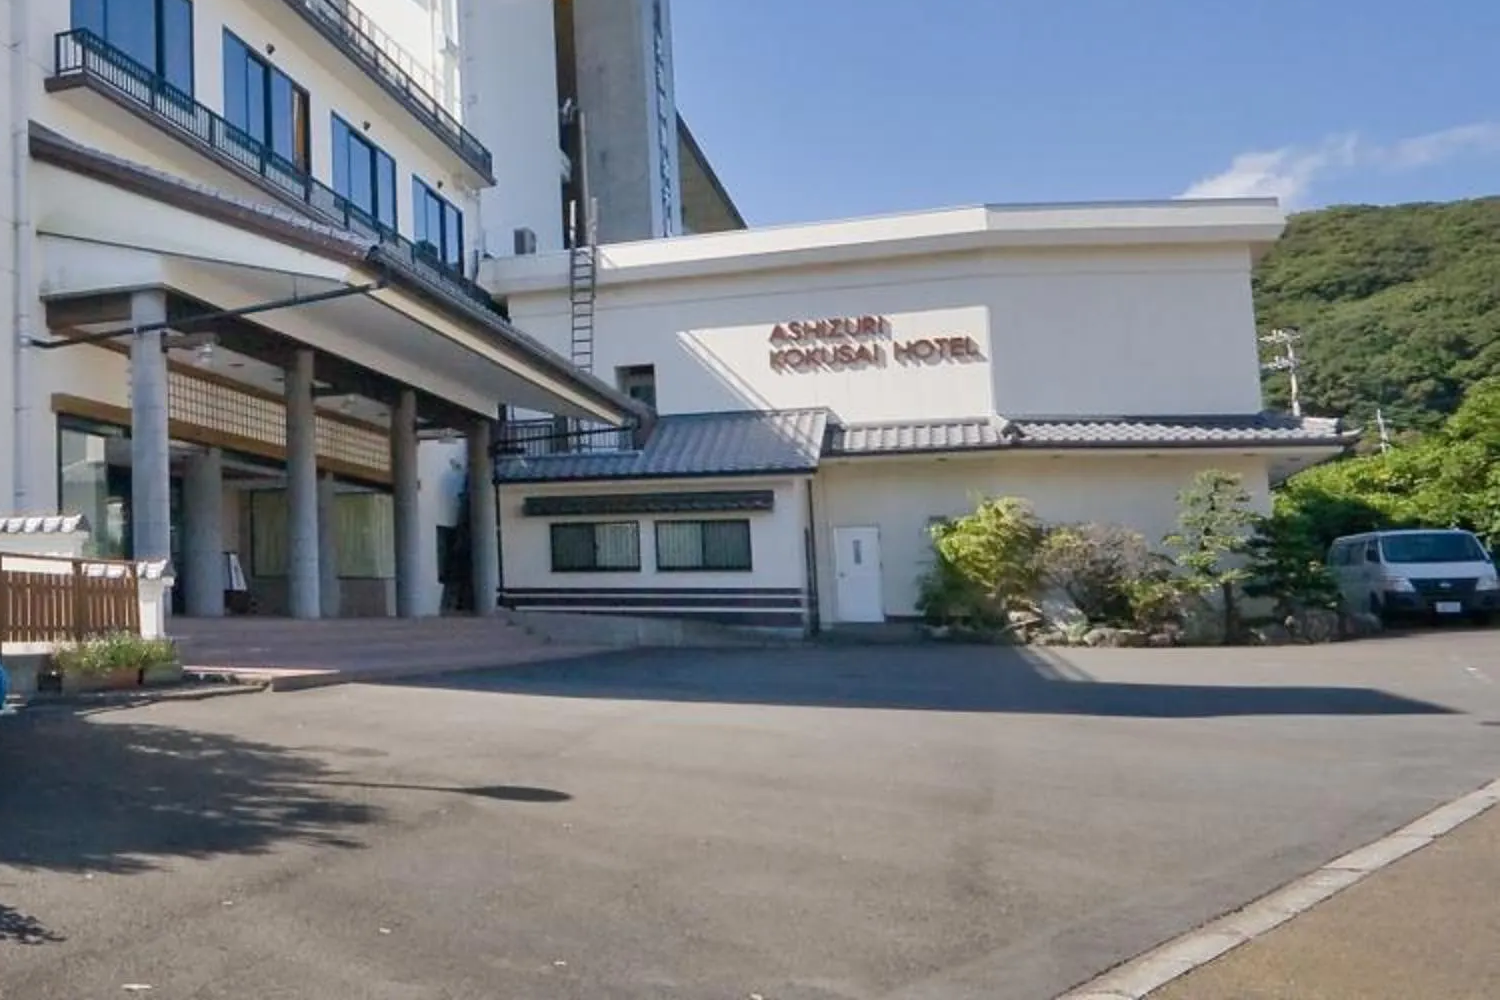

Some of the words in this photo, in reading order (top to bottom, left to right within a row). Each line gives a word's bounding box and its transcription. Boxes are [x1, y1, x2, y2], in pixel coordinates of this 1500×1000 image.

[768, 315, 890, 342] ASHIZURI
[768, 344, 885, 372] KOKUSAI
[893, 336, 983, 364] HOTEL
